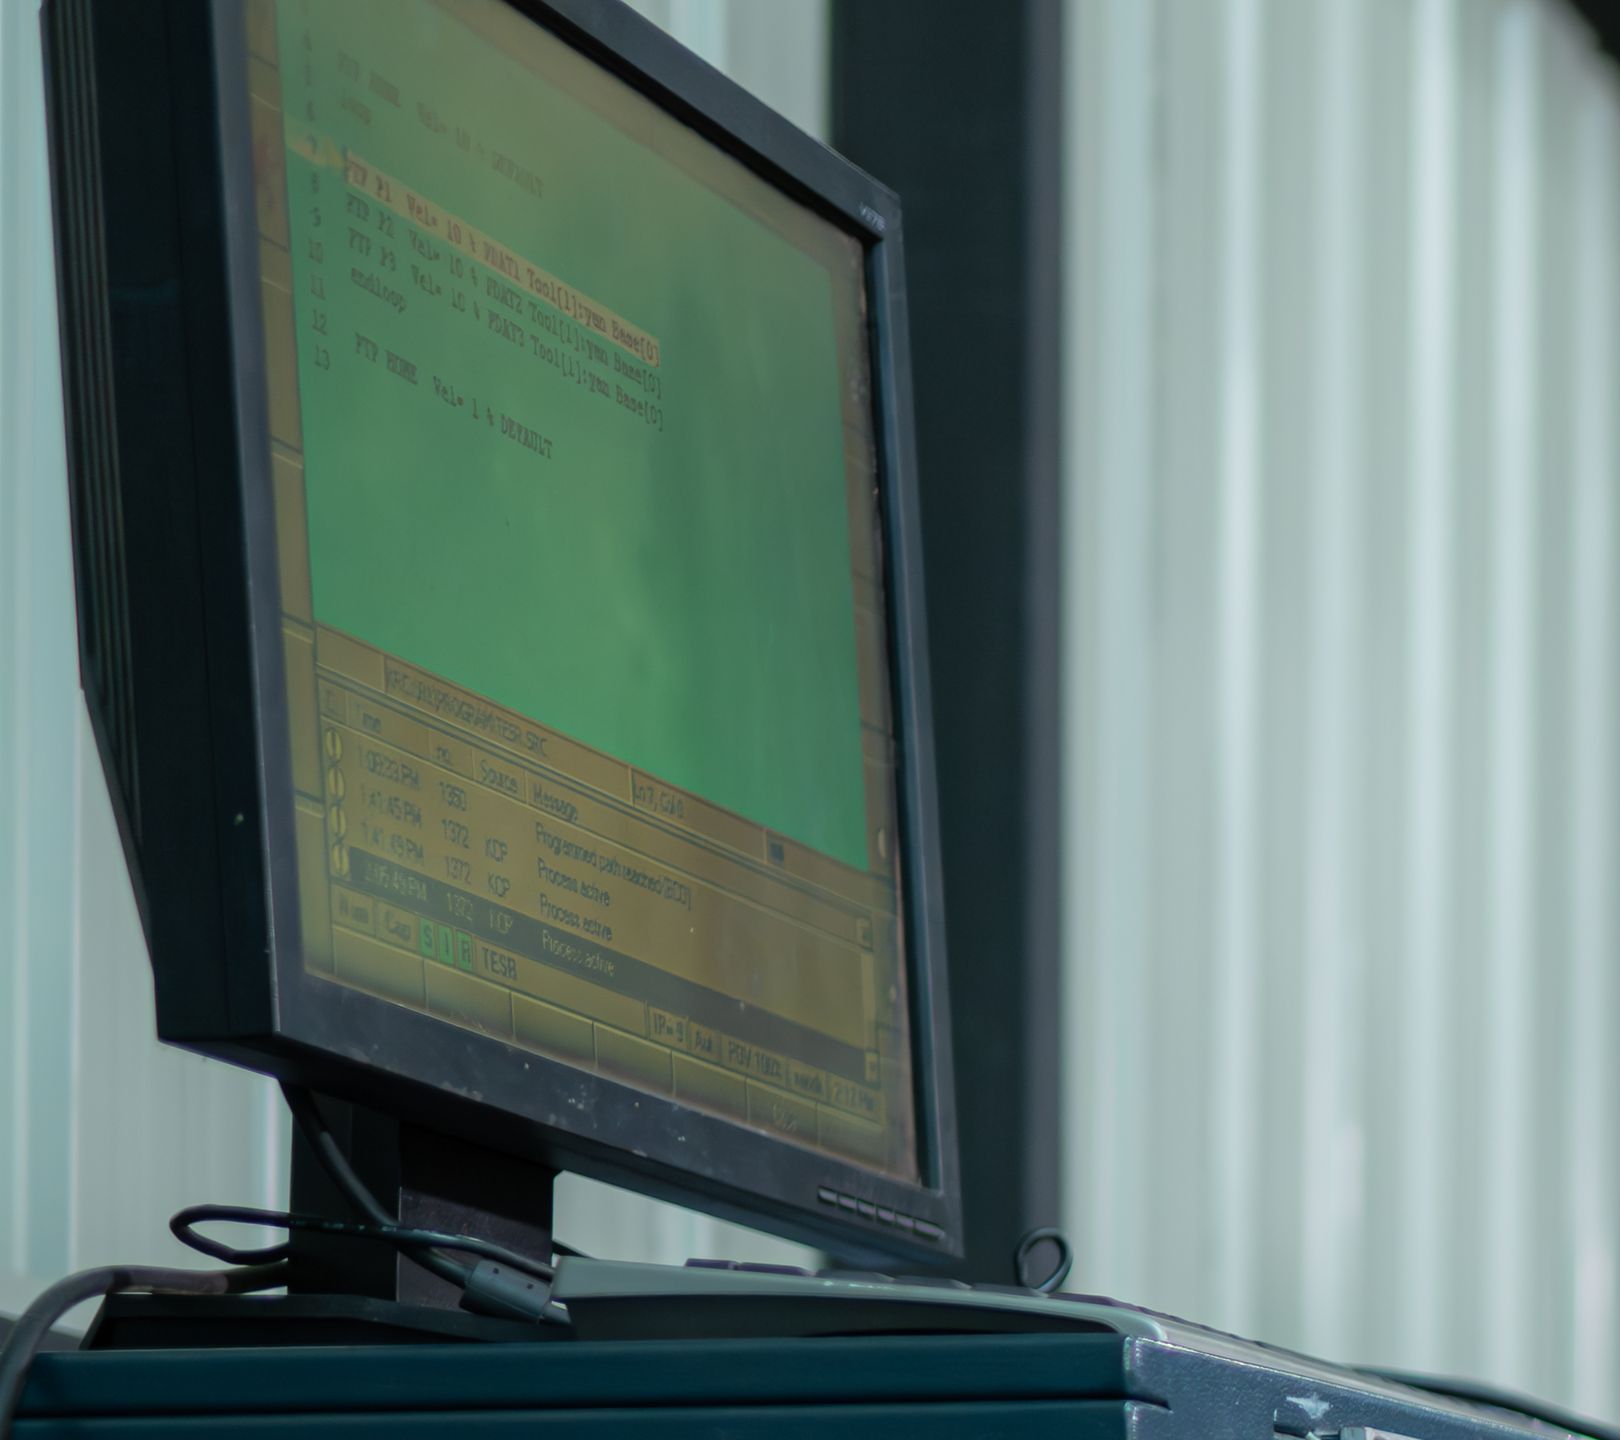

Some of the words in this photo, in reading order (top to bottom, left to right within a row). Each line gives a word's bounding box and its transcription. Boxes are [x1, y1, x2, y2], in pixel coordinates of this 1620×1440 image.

[447, 217, 461, 242] 10
[448, 255, 463, 278] 10
[350, 267, 408, 313] endloop
[311, 309, 328, 335] 12
[313, 345, 329, 370] 13
[481, 759, 518, 794] Source
[441, 819, 471, 850] 1372
[537, 857, 577, 893] Process
[580, 880, 611, 907] active
[583, 916, 613, 942] active
